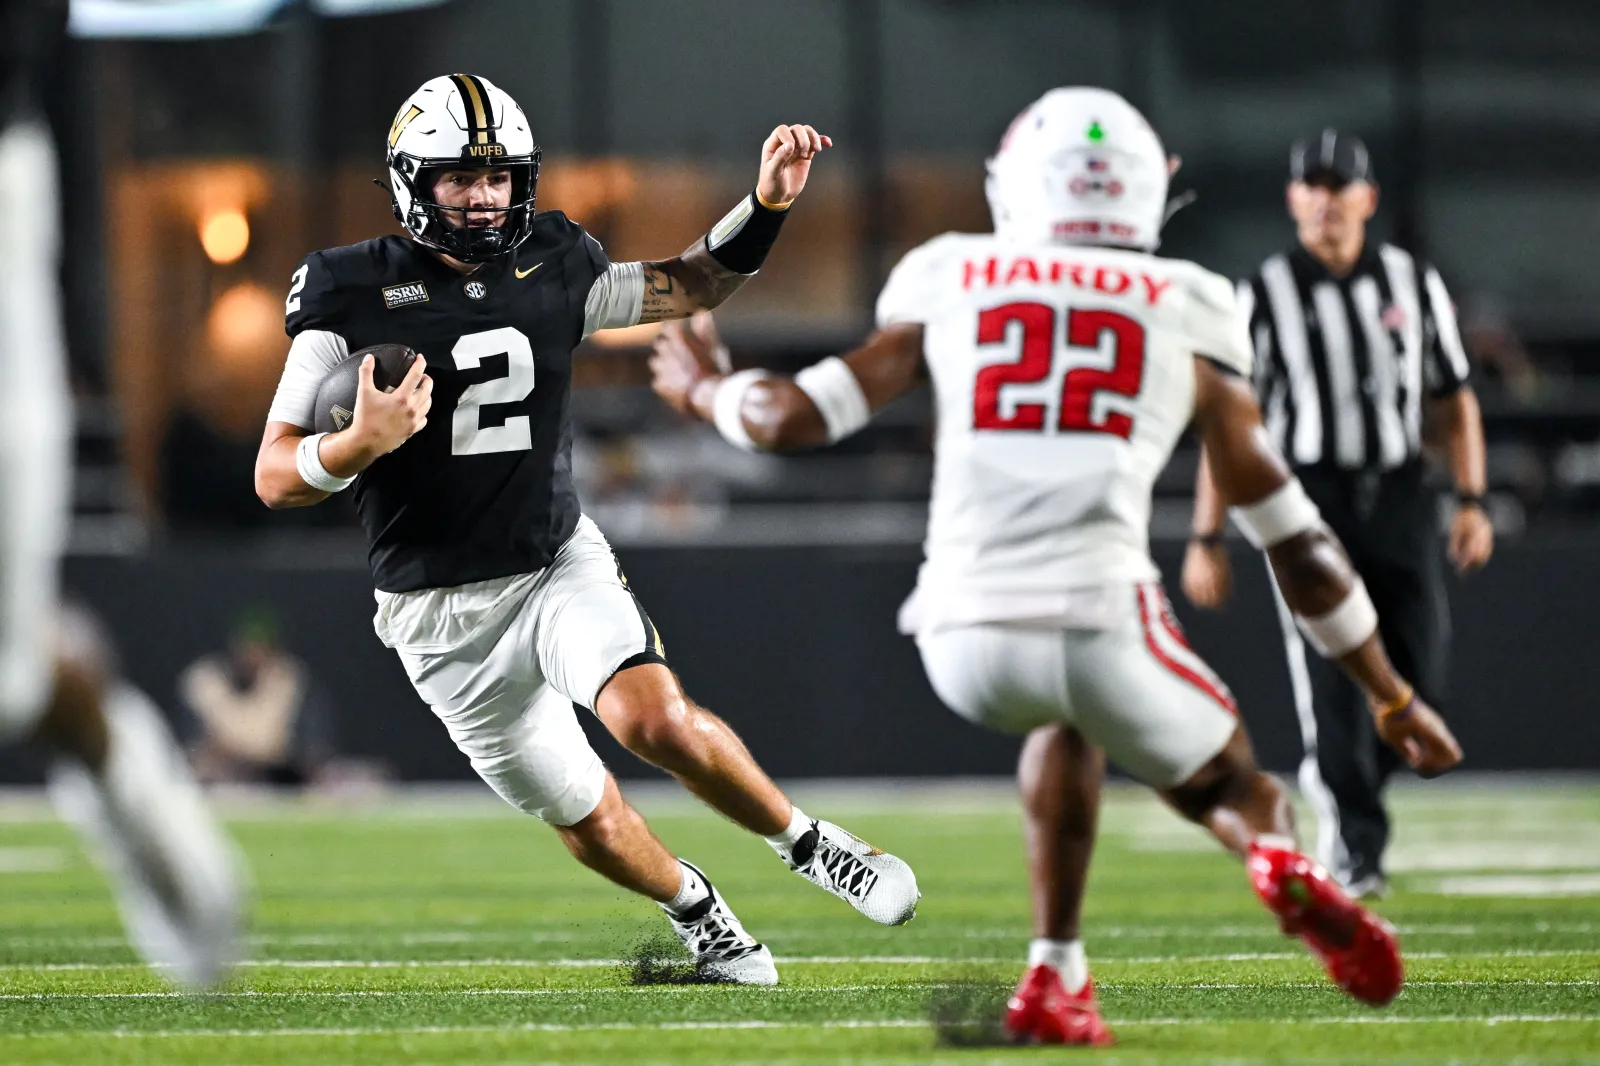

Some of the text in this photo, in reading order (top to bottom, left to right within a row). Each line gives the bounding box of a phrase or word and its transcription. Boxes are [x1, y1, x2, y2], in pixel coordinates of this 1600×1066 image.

[469, 146, 503, 157] VUFB
[286, 264, 309, 316] 2
[392, 284, 426, 301] SRM
[466, 282, 485, 299] SEC
[962, 256, 1170, 306] HARDY
[388, 294, 427, 306] CONCRETE
[973, 301, 1146, 443] 22
[451, 326, 535, 456] 2
